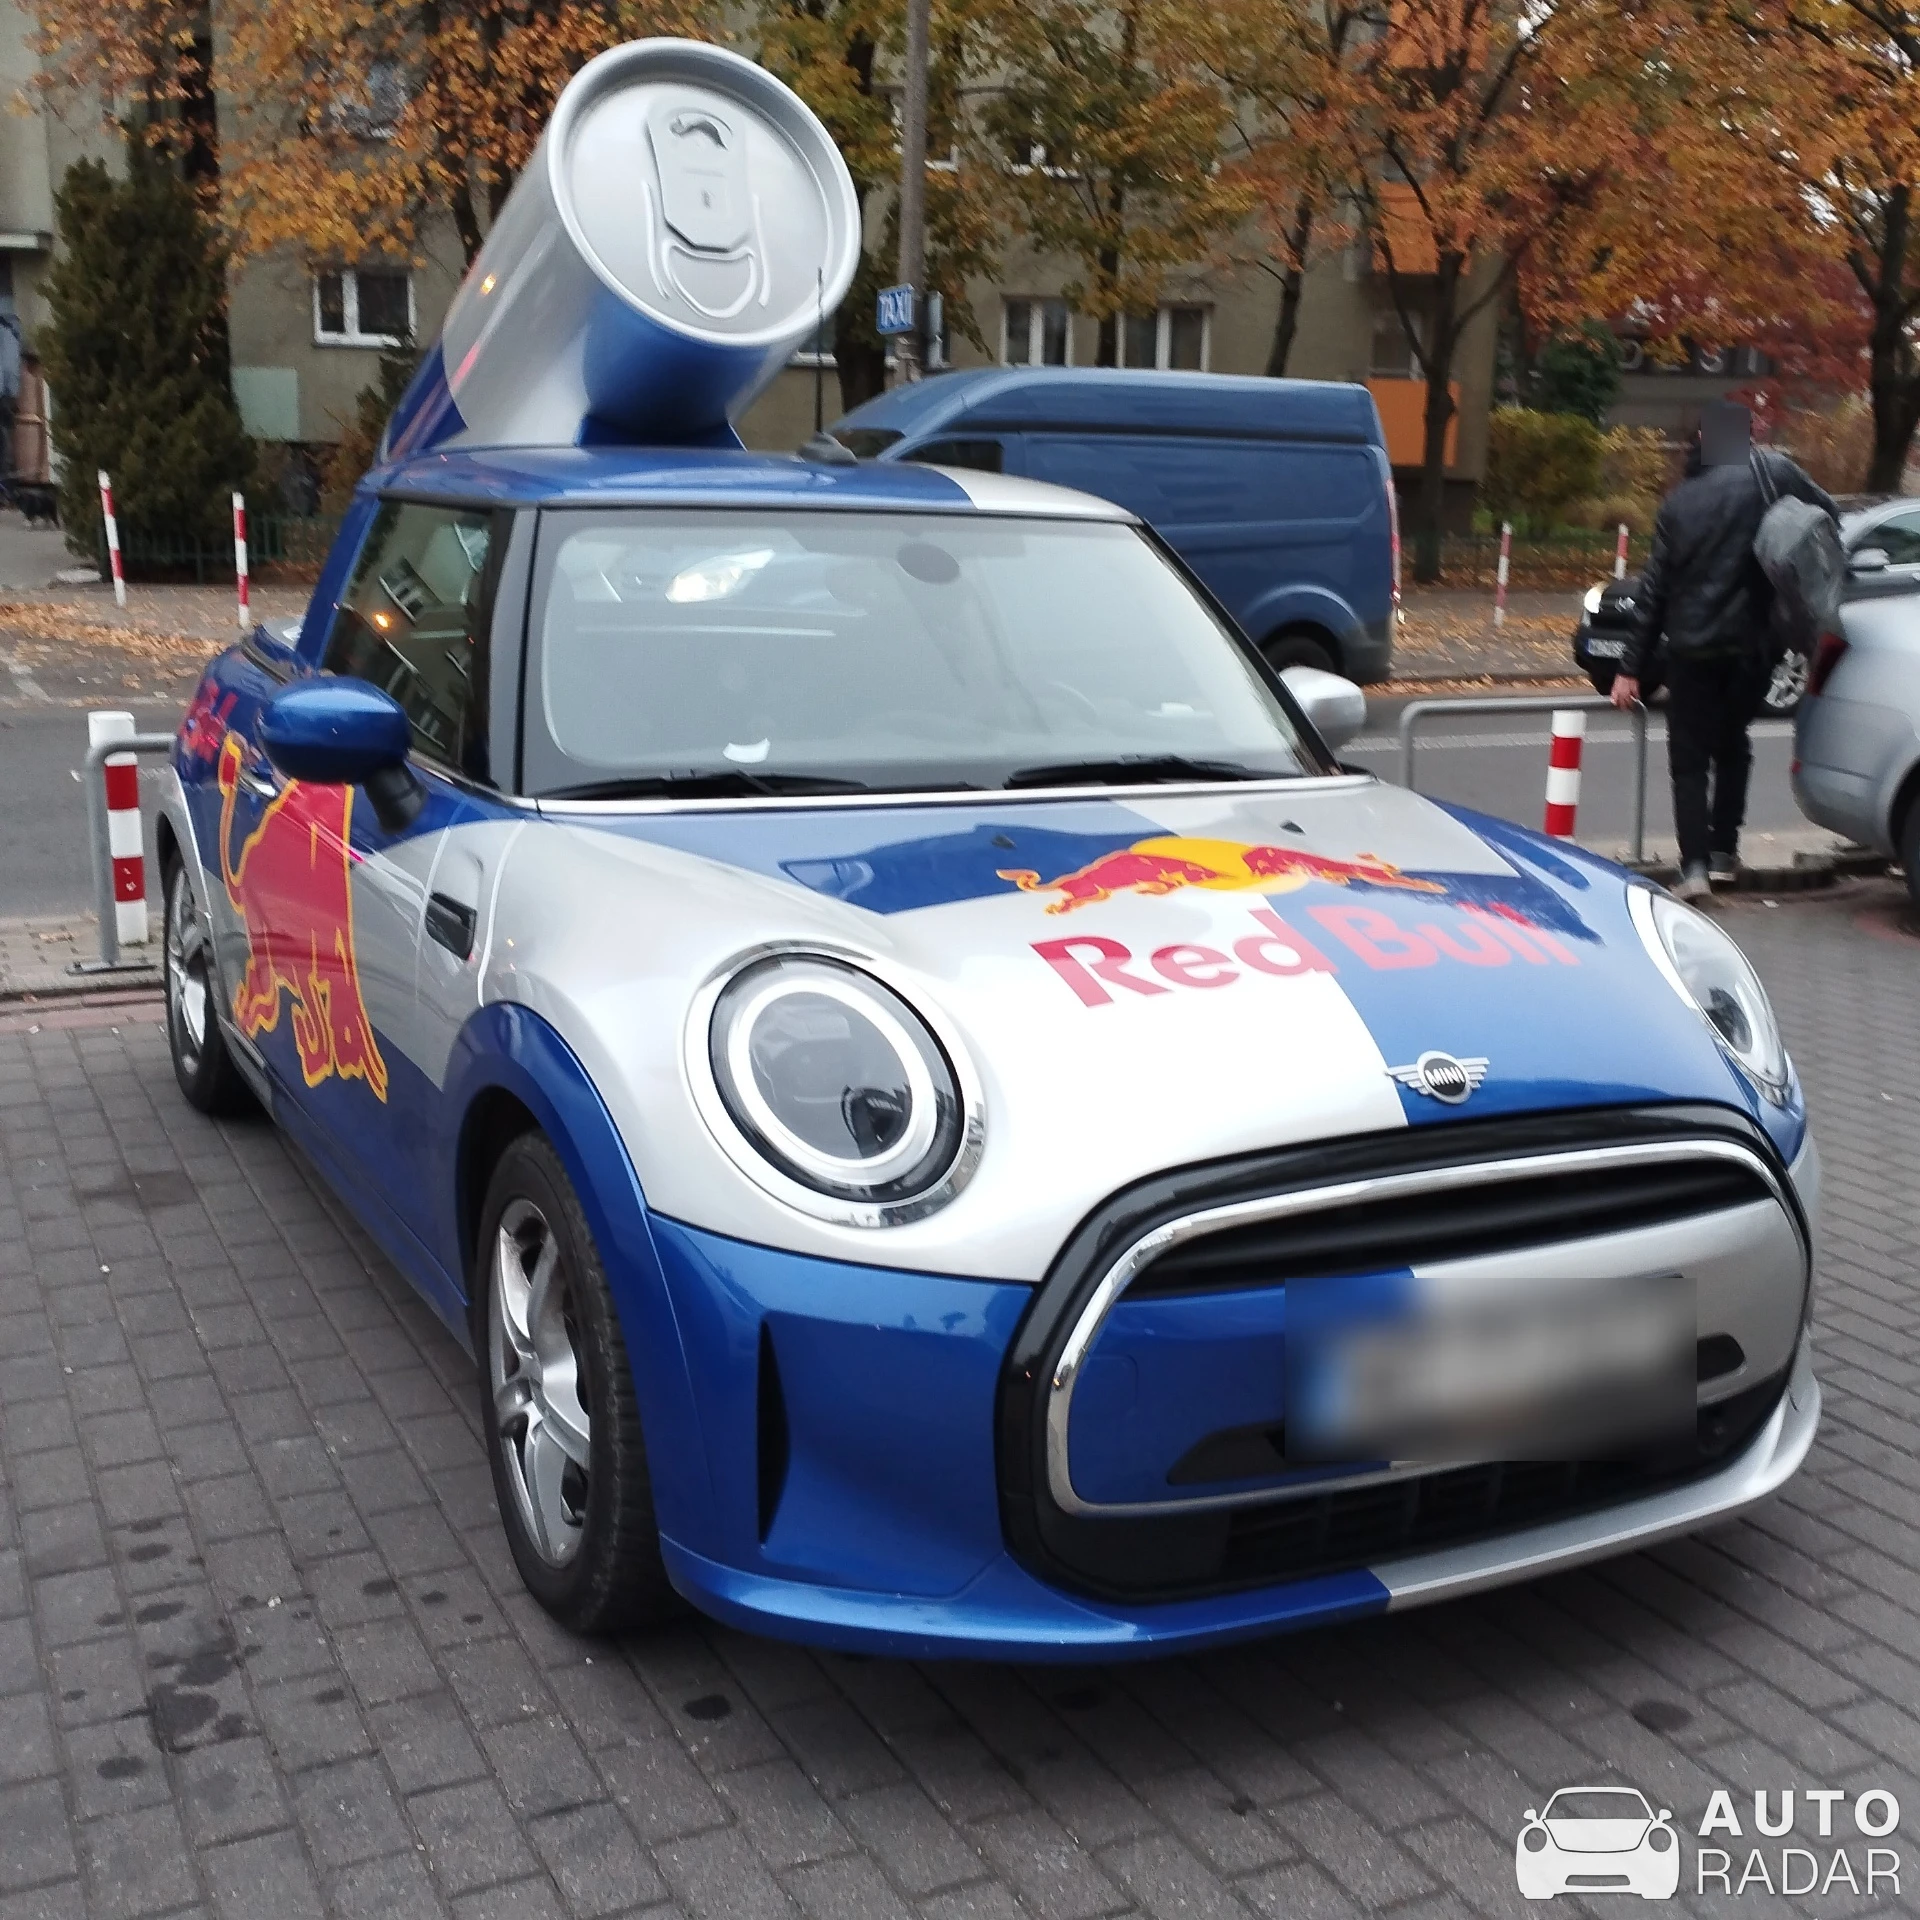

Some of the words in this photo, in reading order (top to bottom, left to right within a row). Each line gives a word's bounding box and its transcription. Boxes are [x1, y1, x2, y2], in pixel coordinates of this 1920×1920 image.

[879, 290, 912, 327] TAXI
[1030, 909, 1338, 1008] Red
[1306, 903, 1582, 971] Bull
[1424, 1066, 1466, 1087] MINI
